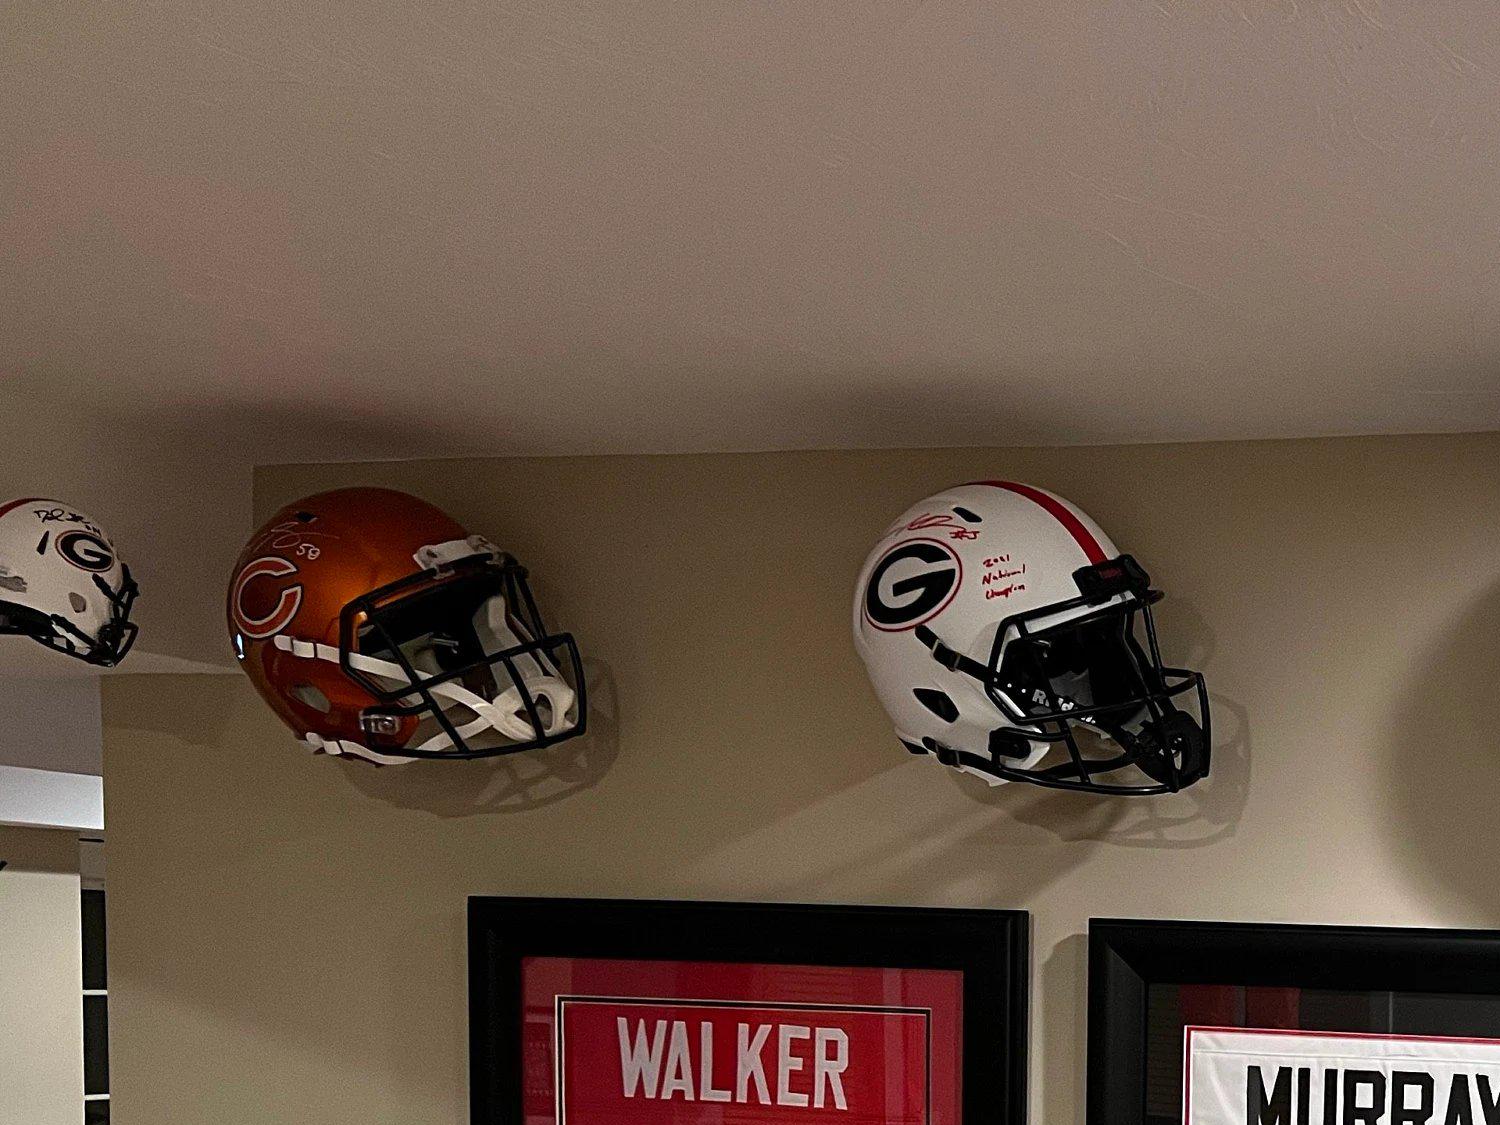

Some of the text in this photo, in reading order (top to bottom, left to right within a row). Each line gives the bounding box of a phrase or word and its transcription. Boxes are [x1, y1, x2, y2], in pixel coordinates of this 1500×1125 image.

[60, 533, 113, 570] G
[865, 542, 957, 625] G
[616, 1016, 849, 1111] WALKER
